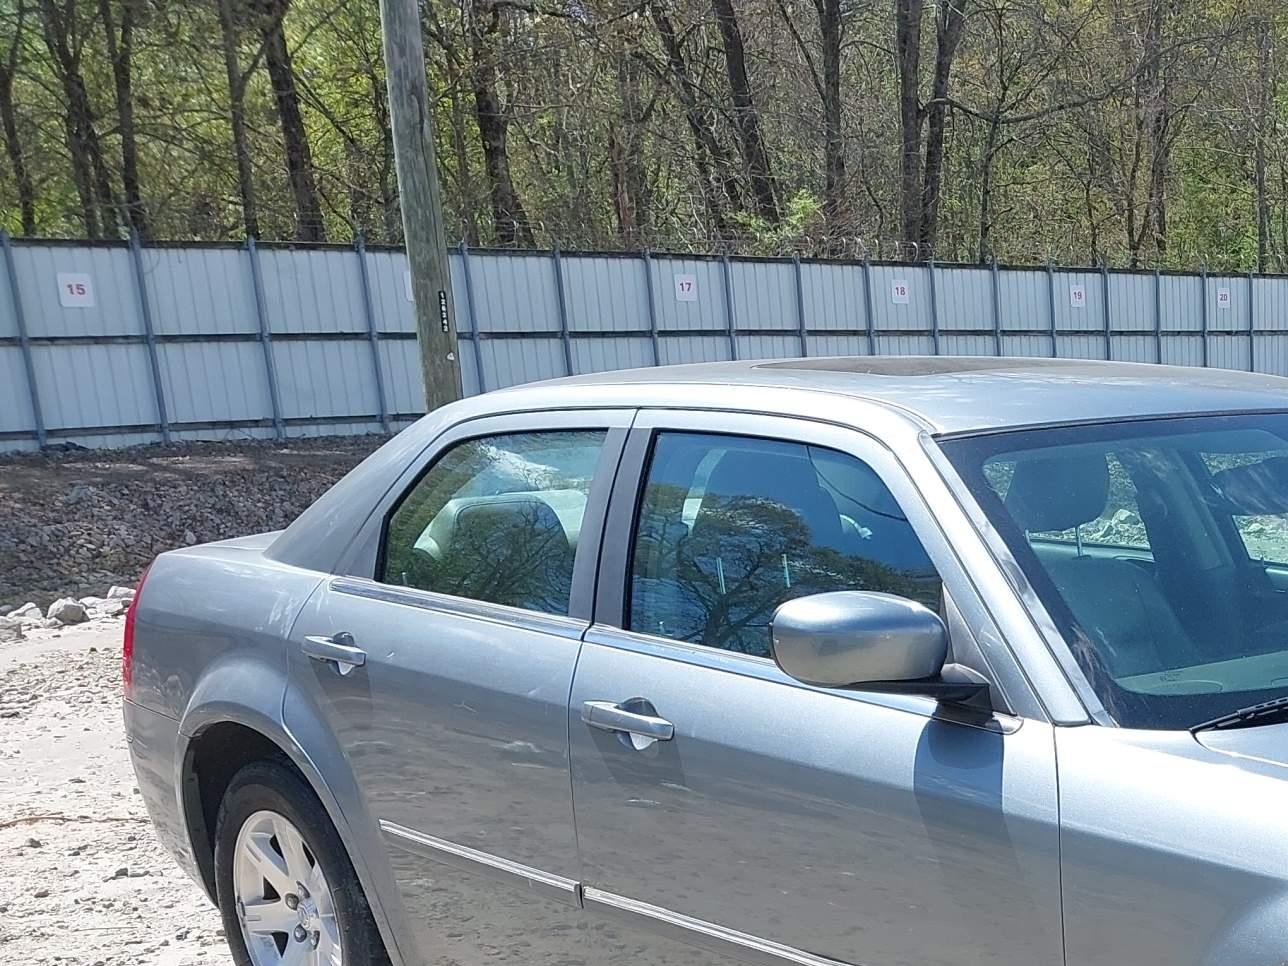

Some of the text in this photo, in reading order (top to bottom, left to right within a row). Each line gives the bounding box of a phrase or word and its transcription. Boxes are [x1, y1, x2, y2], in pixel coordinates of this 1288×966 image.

[66, 283, 86, 296] 15
[679, 282, 692, 292] 17
[895, 286, 906, 296] 18
[1073, 291, 1082, 300] 19
[1219, 293, 1228, 301] 20
